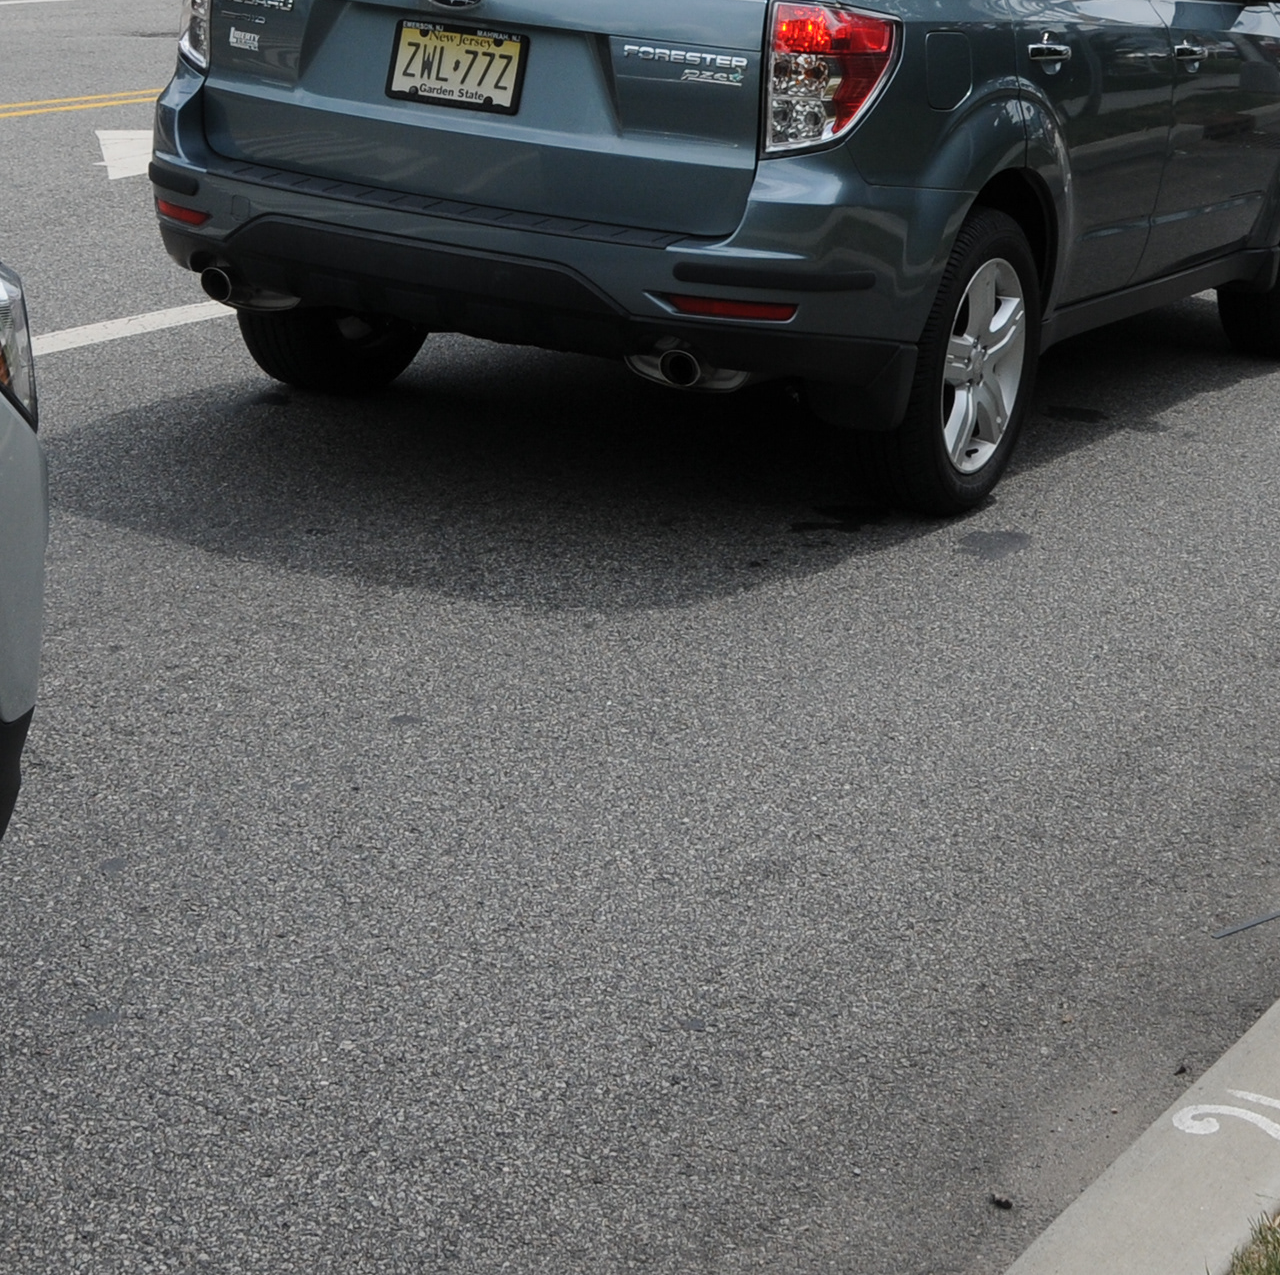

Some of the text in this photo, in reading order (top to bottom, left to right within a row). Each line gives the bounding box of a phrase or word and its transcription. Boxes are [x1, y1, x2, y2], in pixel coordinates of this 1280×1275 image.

[428, 30, 494, 50] New Jersey
[623, 44, 748, 69] FORESTER
[419, 83, 485, 101] Garden State
